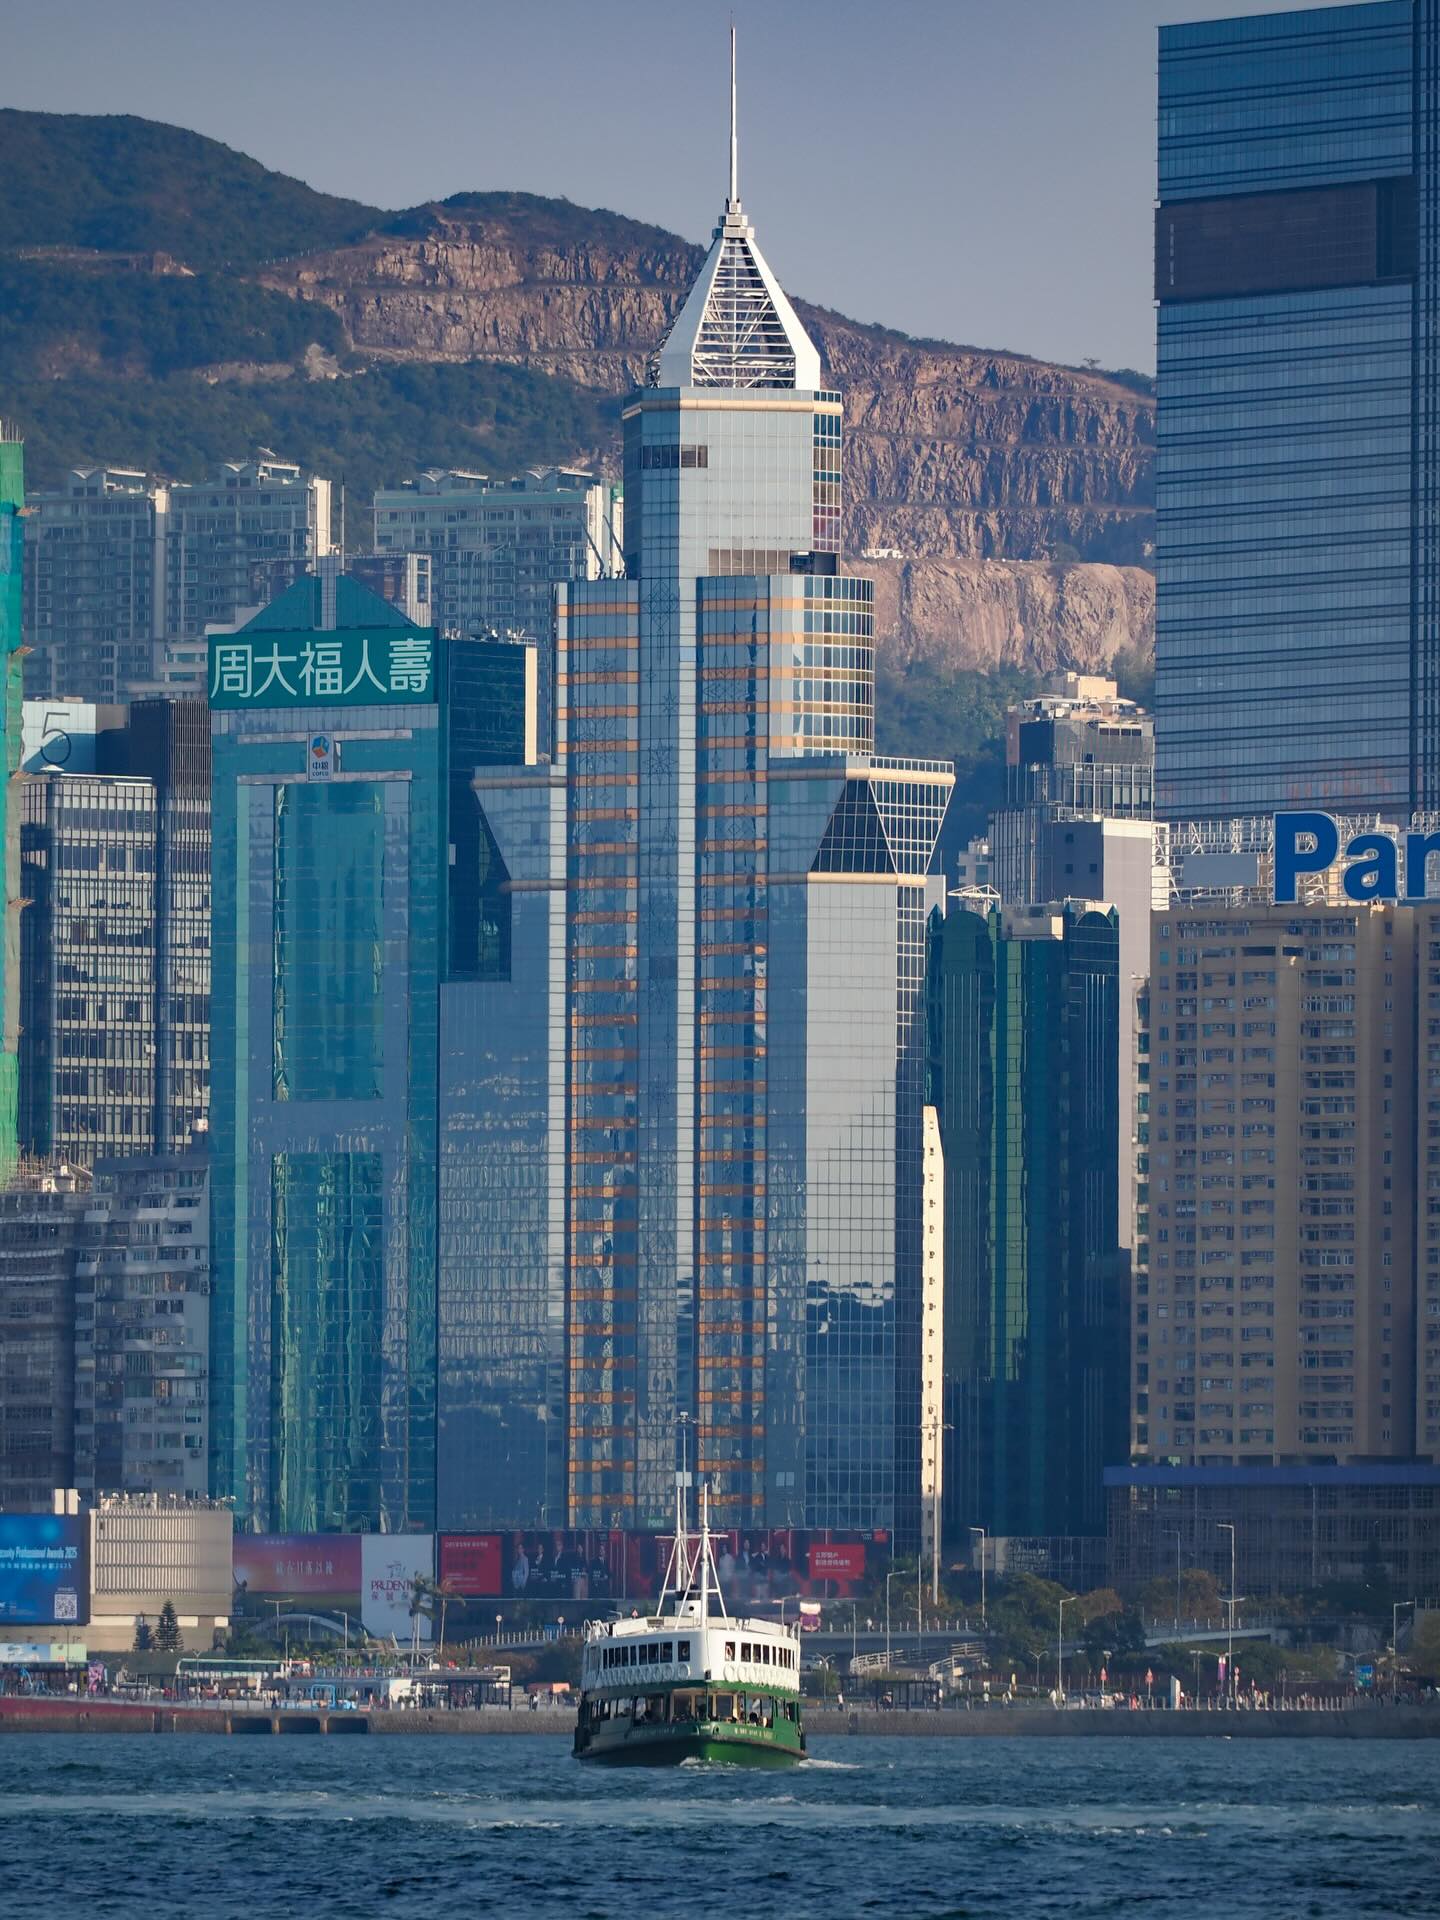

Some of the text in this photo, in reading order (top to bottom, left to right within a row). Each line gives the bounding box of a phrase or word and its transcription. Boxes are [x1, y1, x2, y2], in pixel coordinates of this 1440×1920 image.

[210, 637, 432, 699] 周大福人壽
[40, 711, 72, 765] 5
